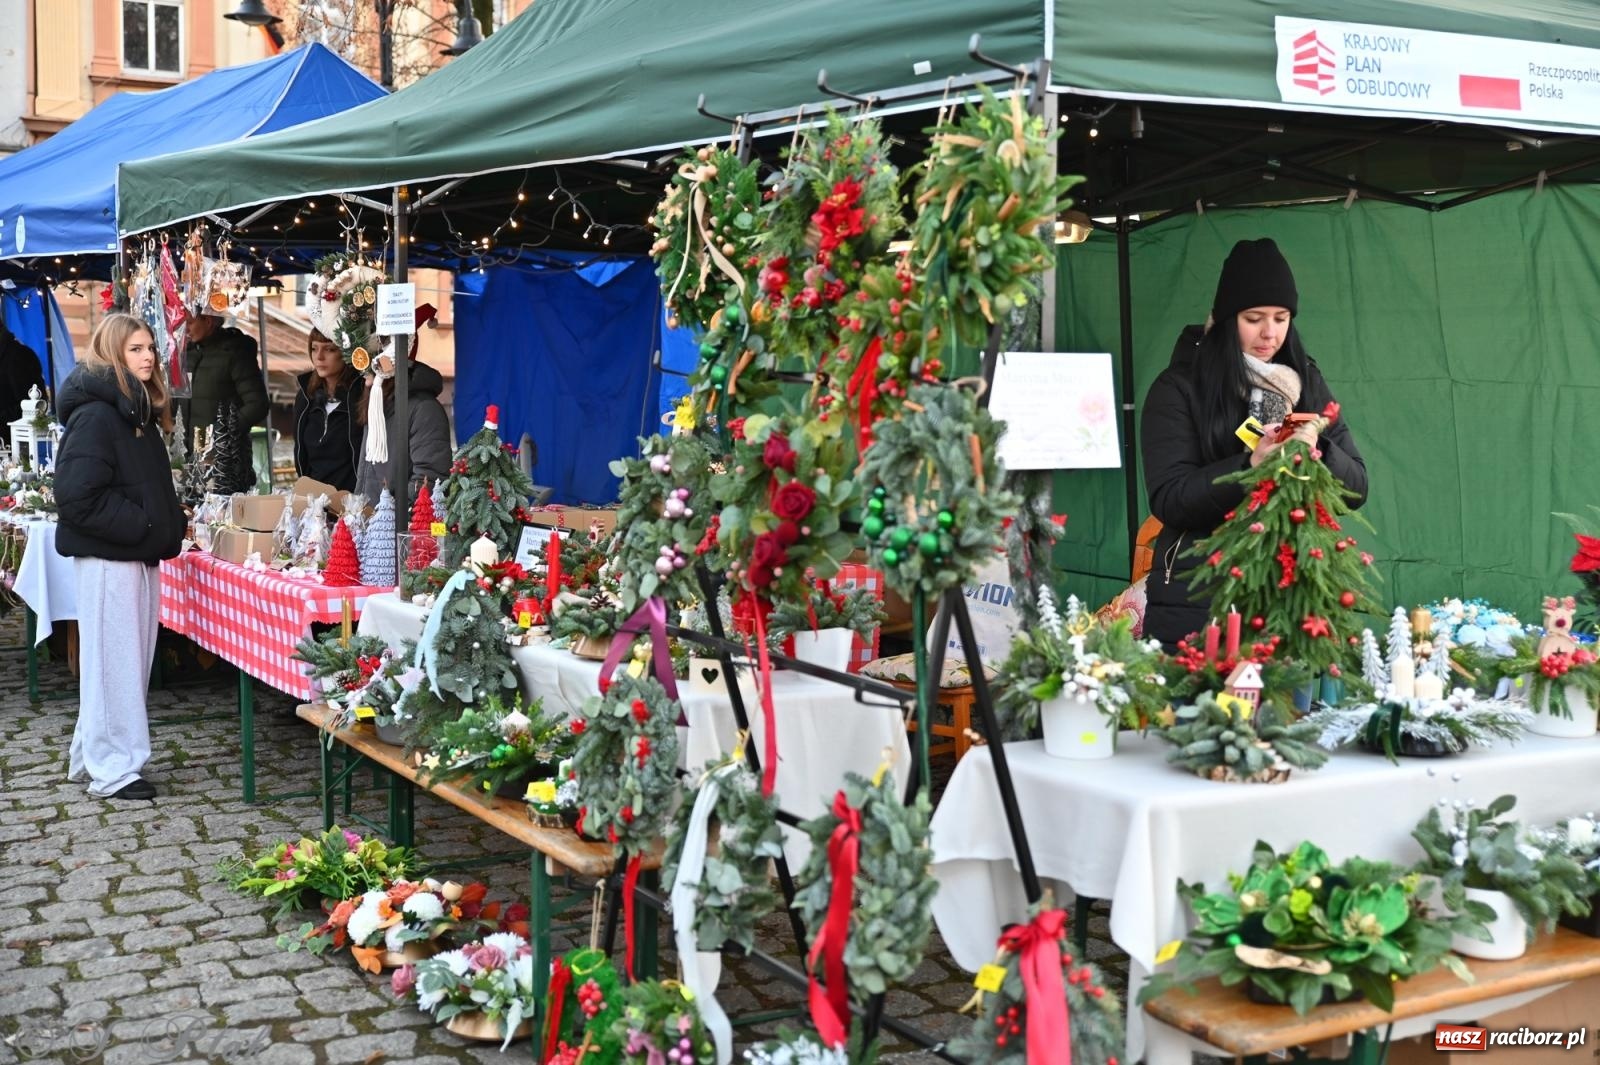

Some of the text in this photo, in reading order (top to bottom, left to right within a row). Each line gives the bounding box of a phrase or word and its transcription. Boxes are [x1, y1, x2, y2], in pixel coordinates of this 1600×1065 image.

[1343, 32, 1410, 54] KRAJOWY
[1345, 55, 1382, 73] PLAN
[1346, 77, 1431, 100] ODBUDOWY
[1529, 83, 1564, 100] Polska
